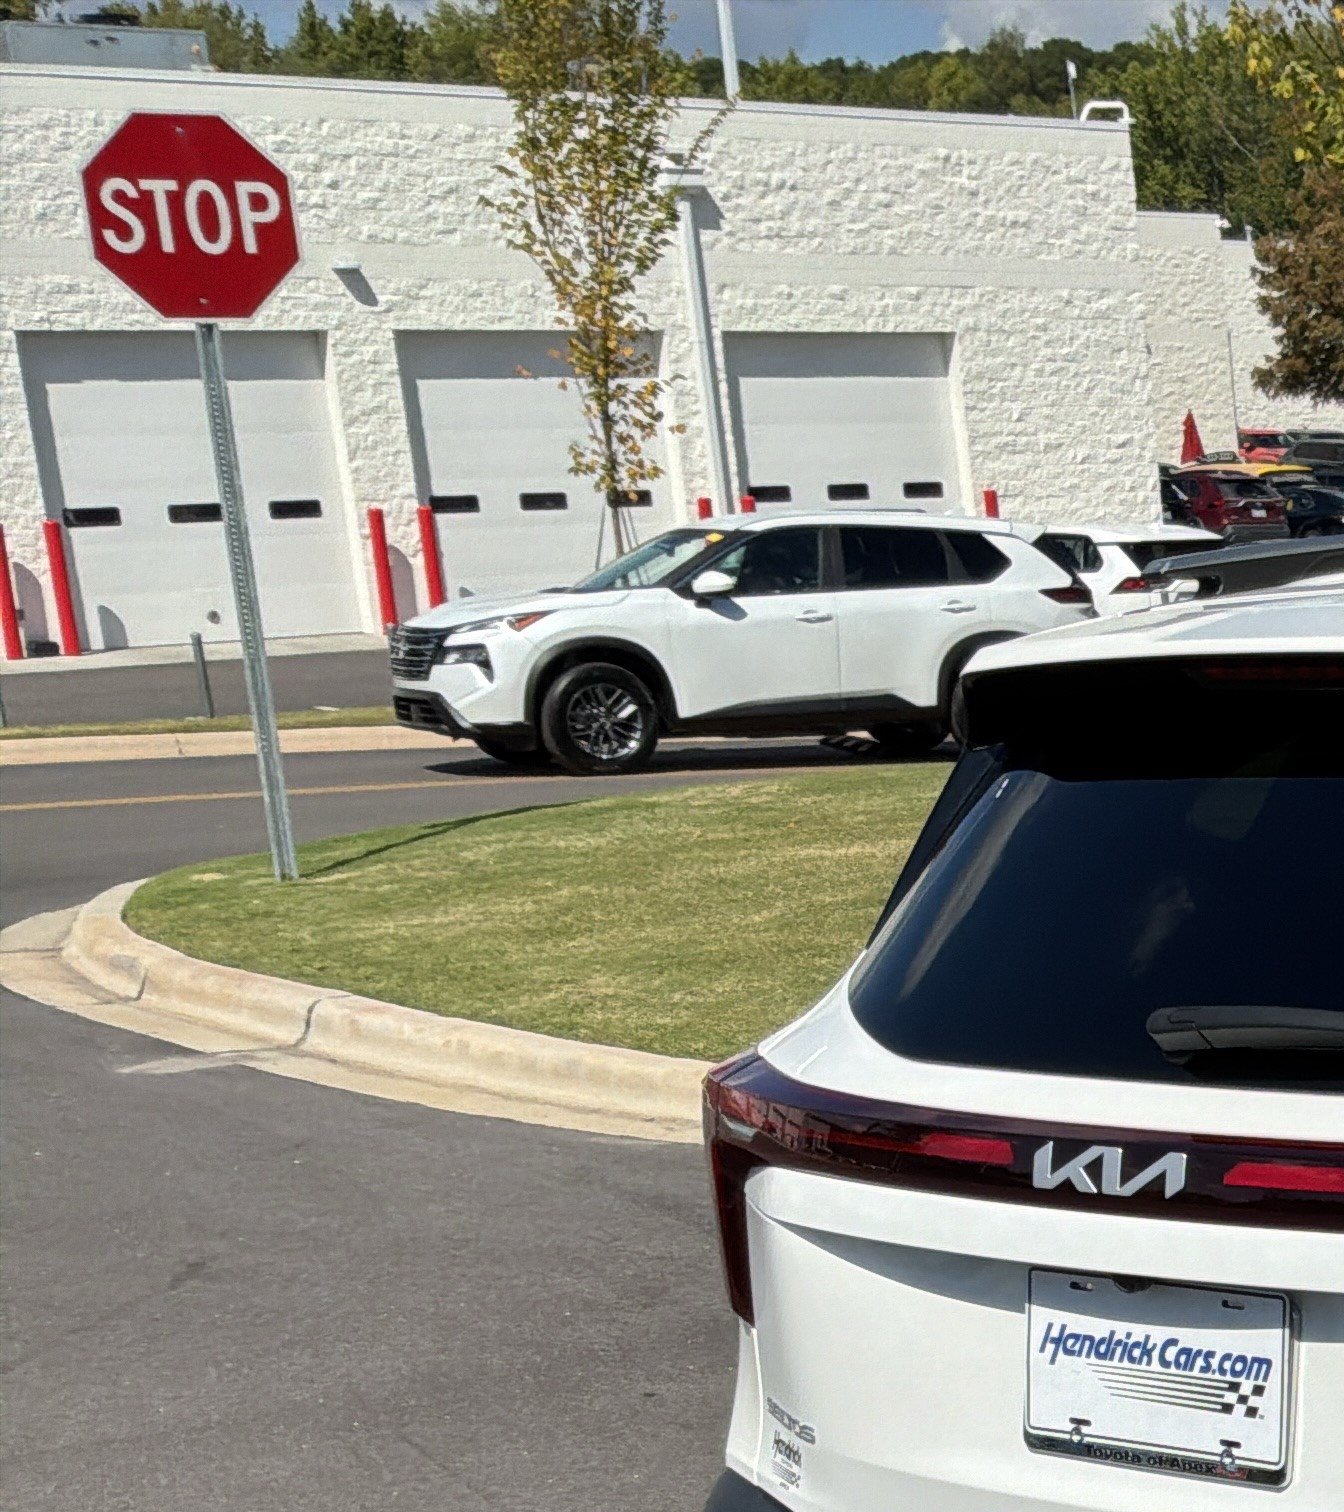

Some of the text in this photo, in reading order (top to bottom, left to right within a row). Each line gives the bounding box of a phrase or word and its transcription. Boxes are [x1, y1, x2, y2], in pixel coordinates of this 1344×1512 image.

[100, 177, 281, 255] STOP
[1032, 1141, 1187, 1199] KIA
[1084, 1443, 1142, 1464] Toyota
[1147, 1453, 1165, 1467] of
[1170, 1457, 1218, 1475] Apex
